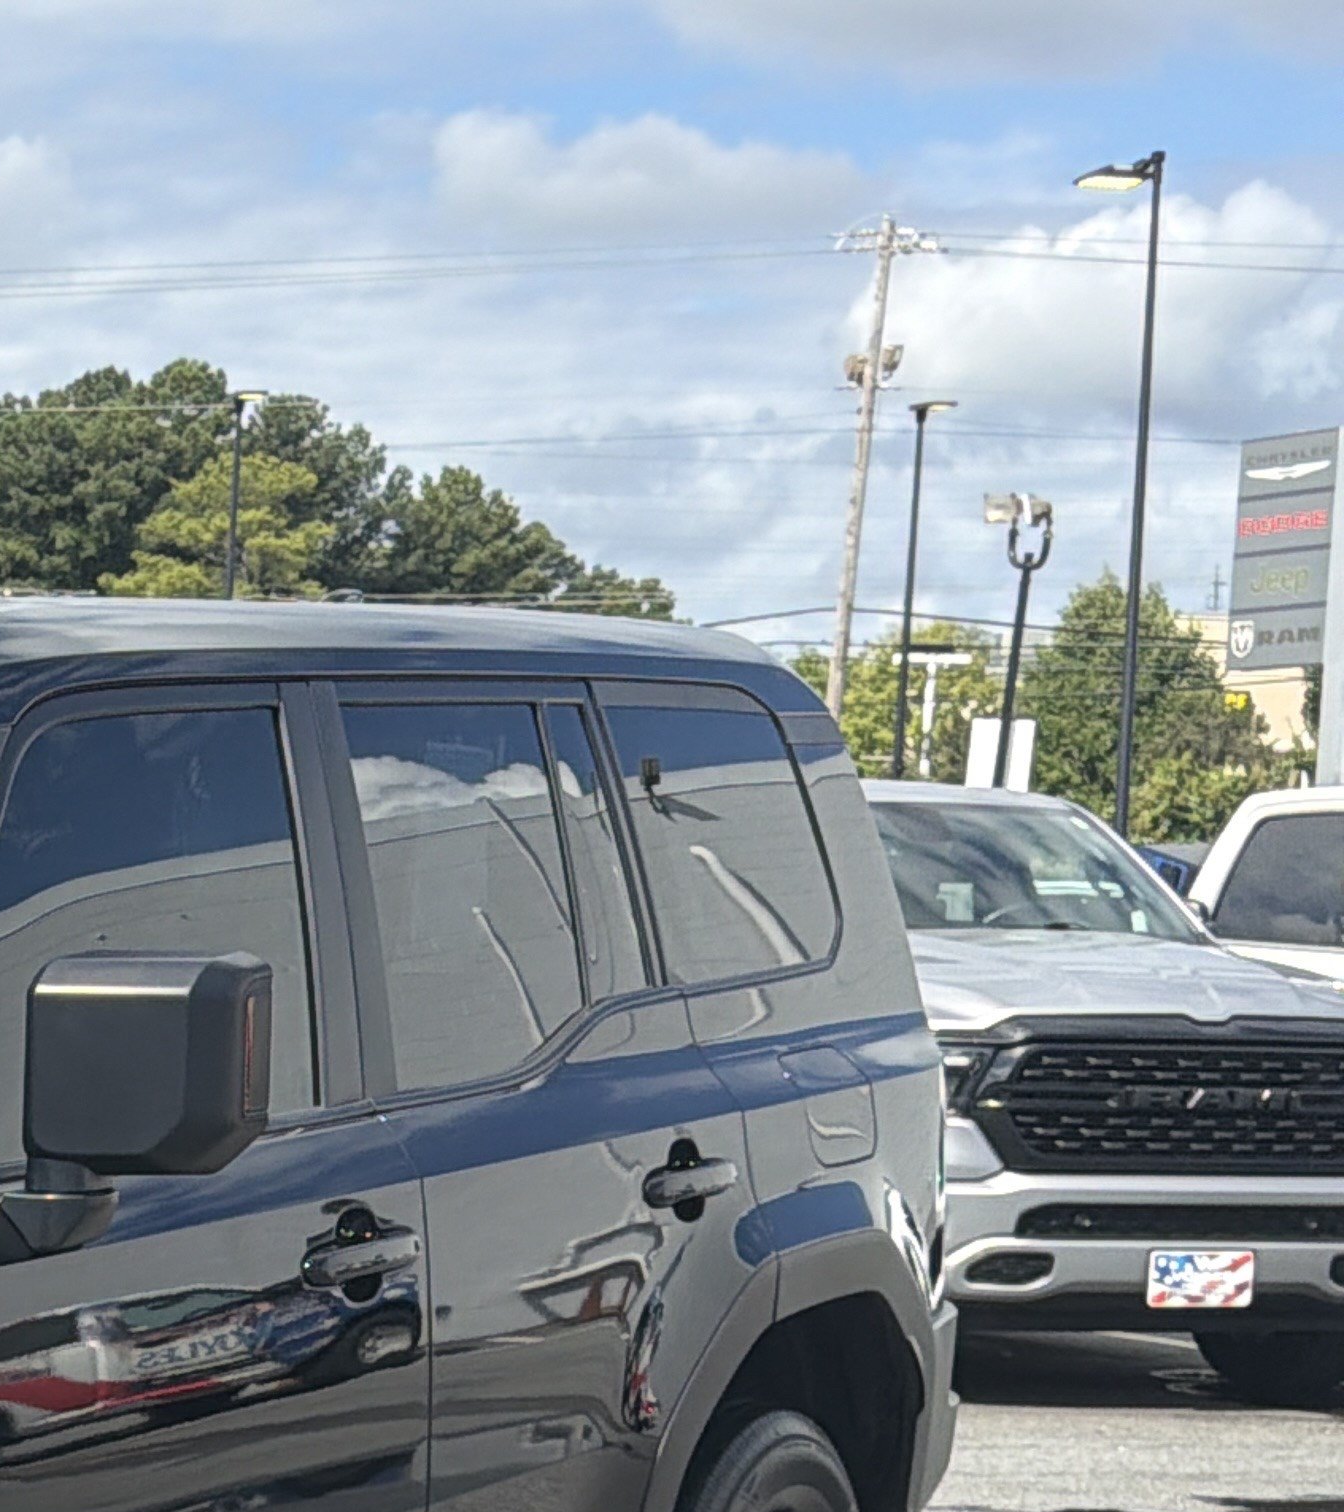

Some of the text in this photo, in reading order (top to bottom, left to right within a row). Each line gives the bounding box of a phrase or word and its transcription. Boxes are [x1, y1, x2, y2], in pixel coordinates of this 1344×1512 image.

[1250, 567, 1312, 595] Jeep
[1258, 625, 1322, 647] RAM
[1128, 1087, 1289, 1110] RAM
